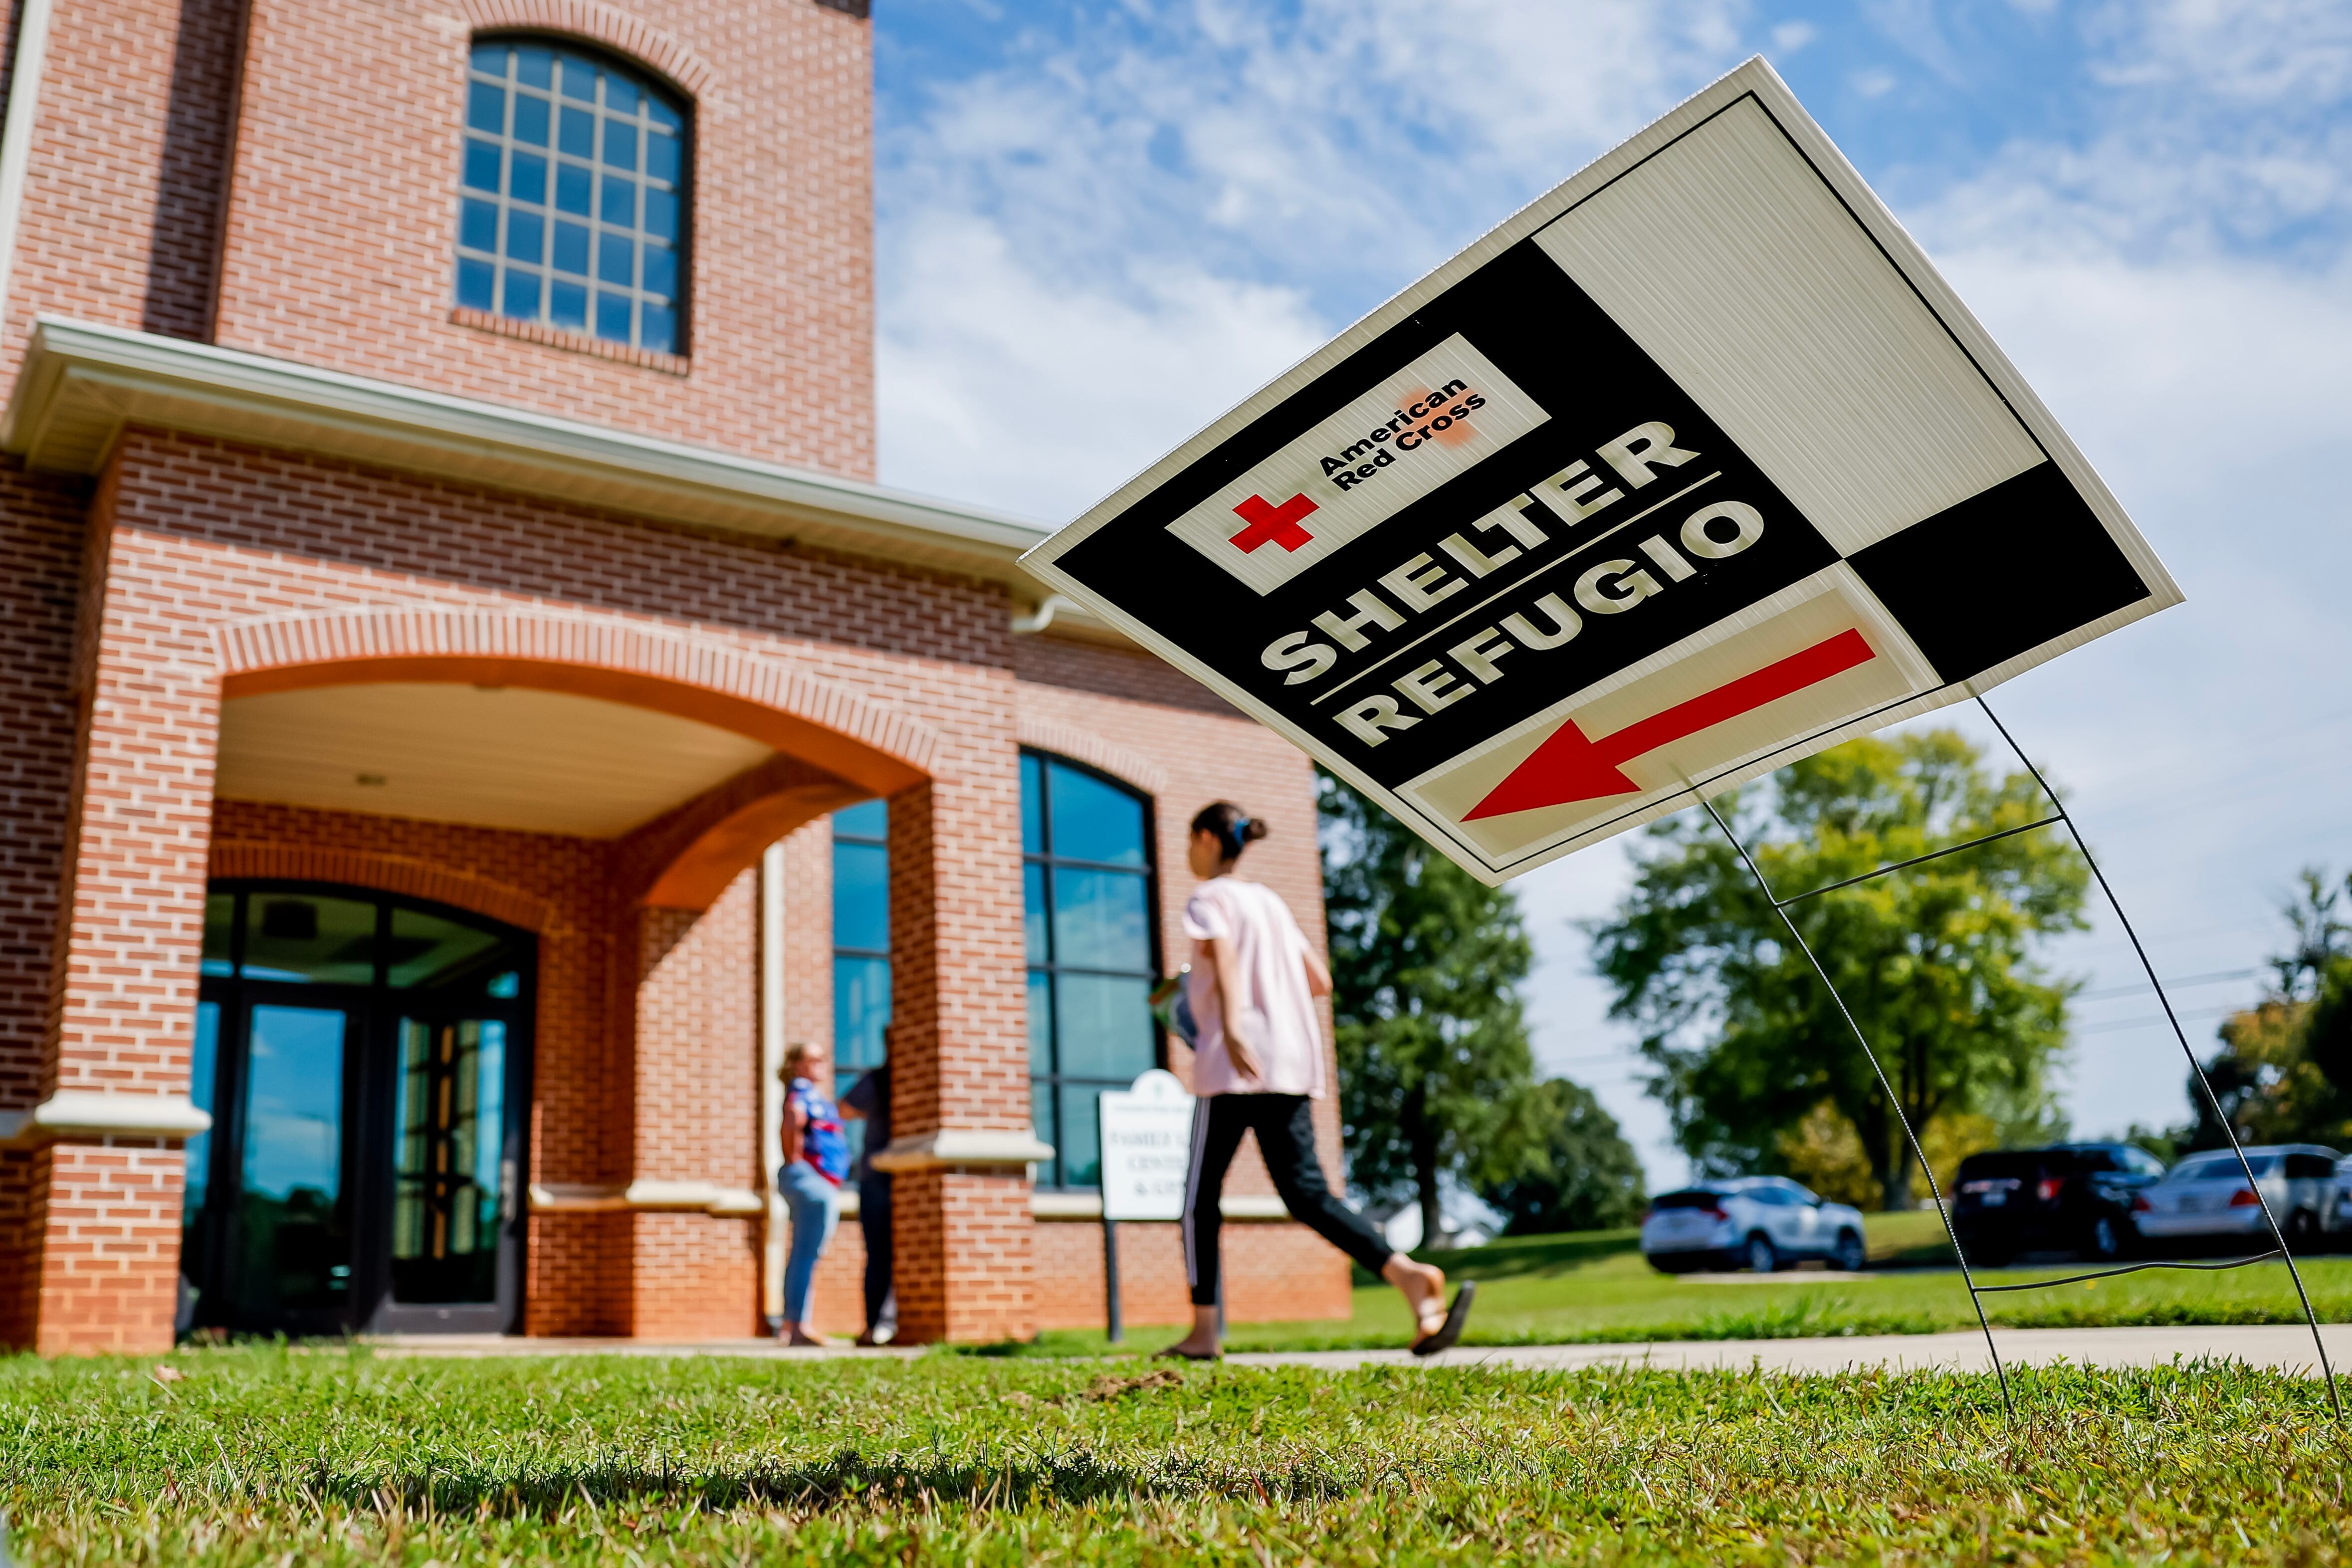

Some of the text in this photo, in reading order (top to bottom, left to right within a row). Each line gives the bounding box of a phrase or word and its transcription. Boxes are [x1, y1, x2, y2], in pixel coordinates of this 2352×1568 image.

[1319, 378, 1469, 478] American
[1330, 393, 1487, 492] Red Cross
[1261, 421, 1702, 686] SHELTER
[1331, 500, 1765, 748] REFUGIO
